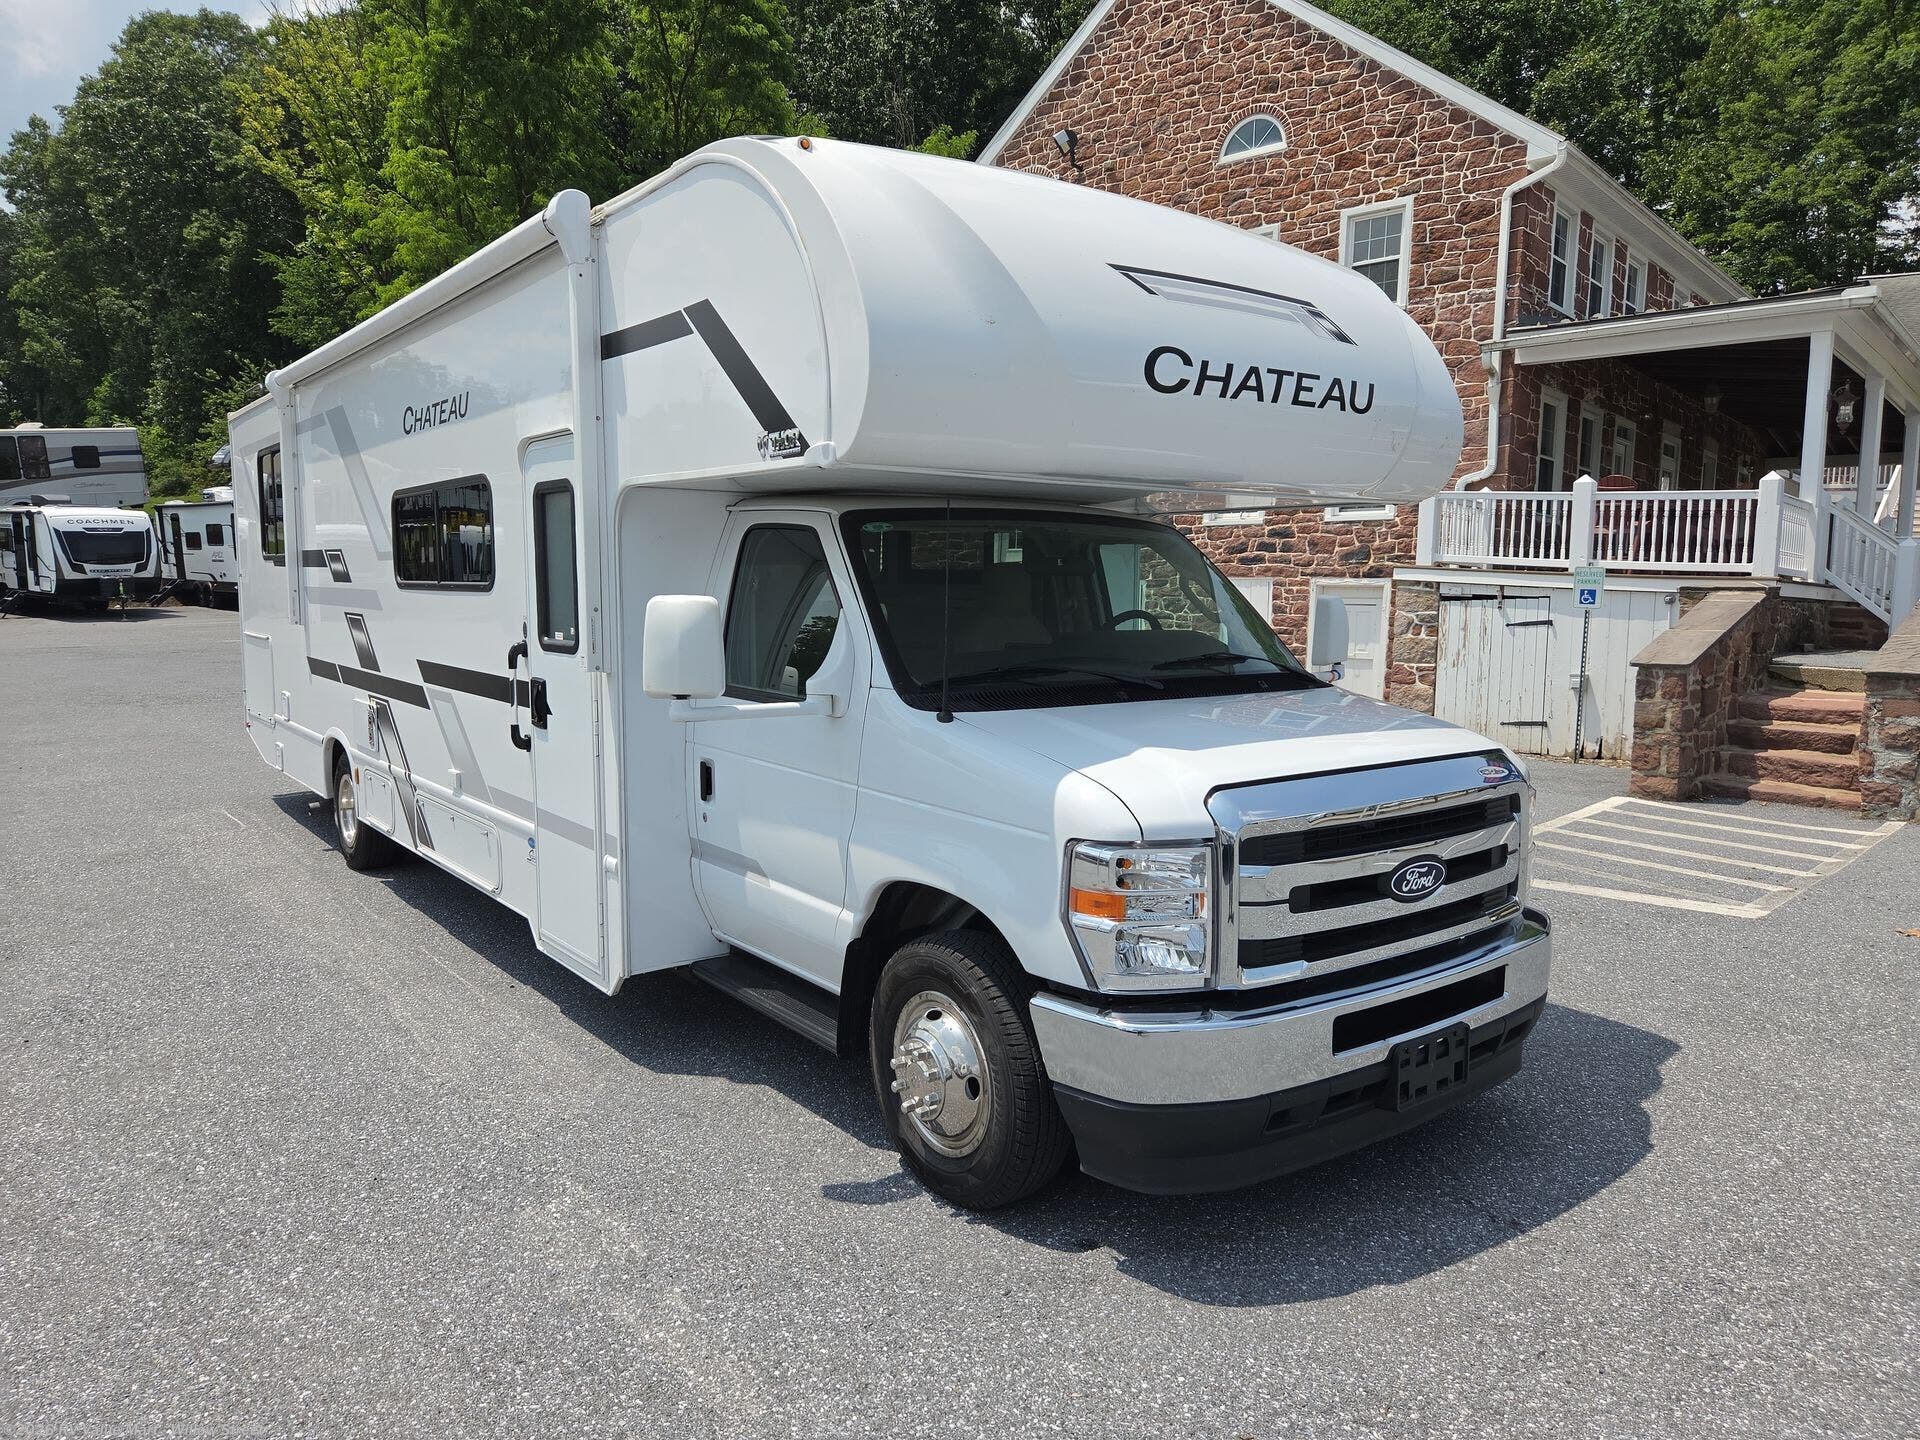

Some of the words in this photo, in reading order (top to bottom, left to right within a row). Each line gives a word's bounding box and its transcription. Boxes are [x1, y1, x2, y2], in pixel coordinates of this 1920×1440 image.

[1143, 345, 1375, 415] CHATEAU
[403, 391, 469, 435] CHATEAU
[769, 427, 801, 452] THOR
[1402, 866, 1436, 892] Ford
